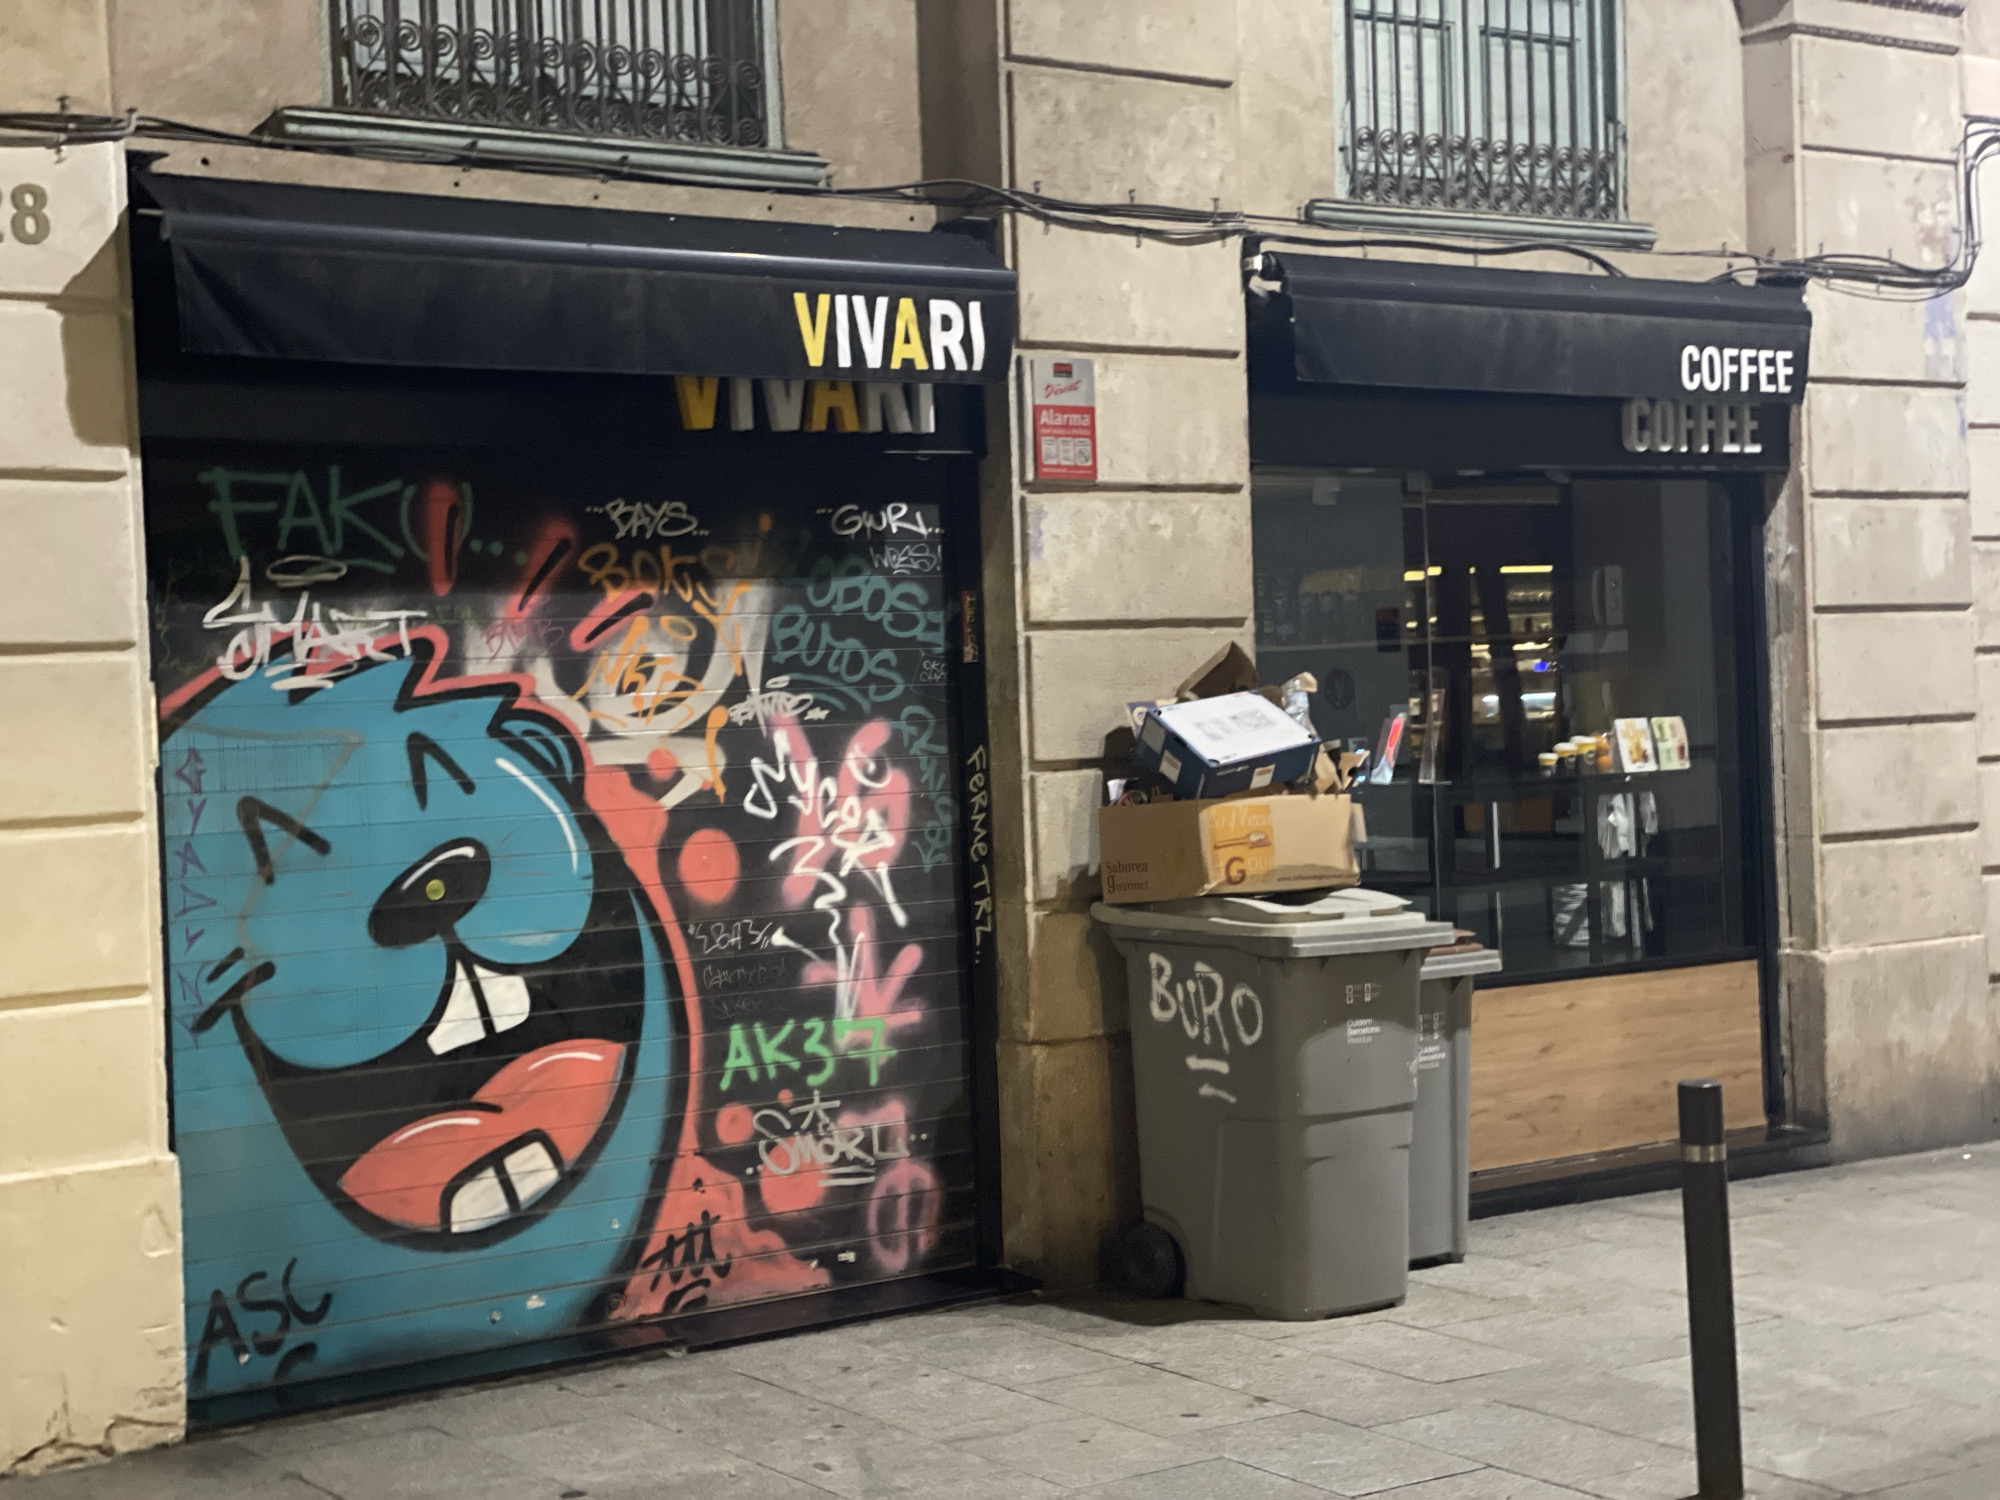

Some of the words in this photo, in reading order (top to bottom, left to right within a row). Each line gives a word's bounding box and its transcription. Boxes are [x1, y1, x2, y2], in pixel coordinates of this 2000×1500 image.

[0, 183, 50, 245] 8
[793, 292, 986, 371] VIVARI
[1681, 345, 1794, 394] COFFEE
[1040, 408, 1091, 426] Alarma
[1621, 399, 1762, 453] COFFEE
[1106, 861, 1148, 873] Saborea
[1107, 874, 1149, 894] gourmet
